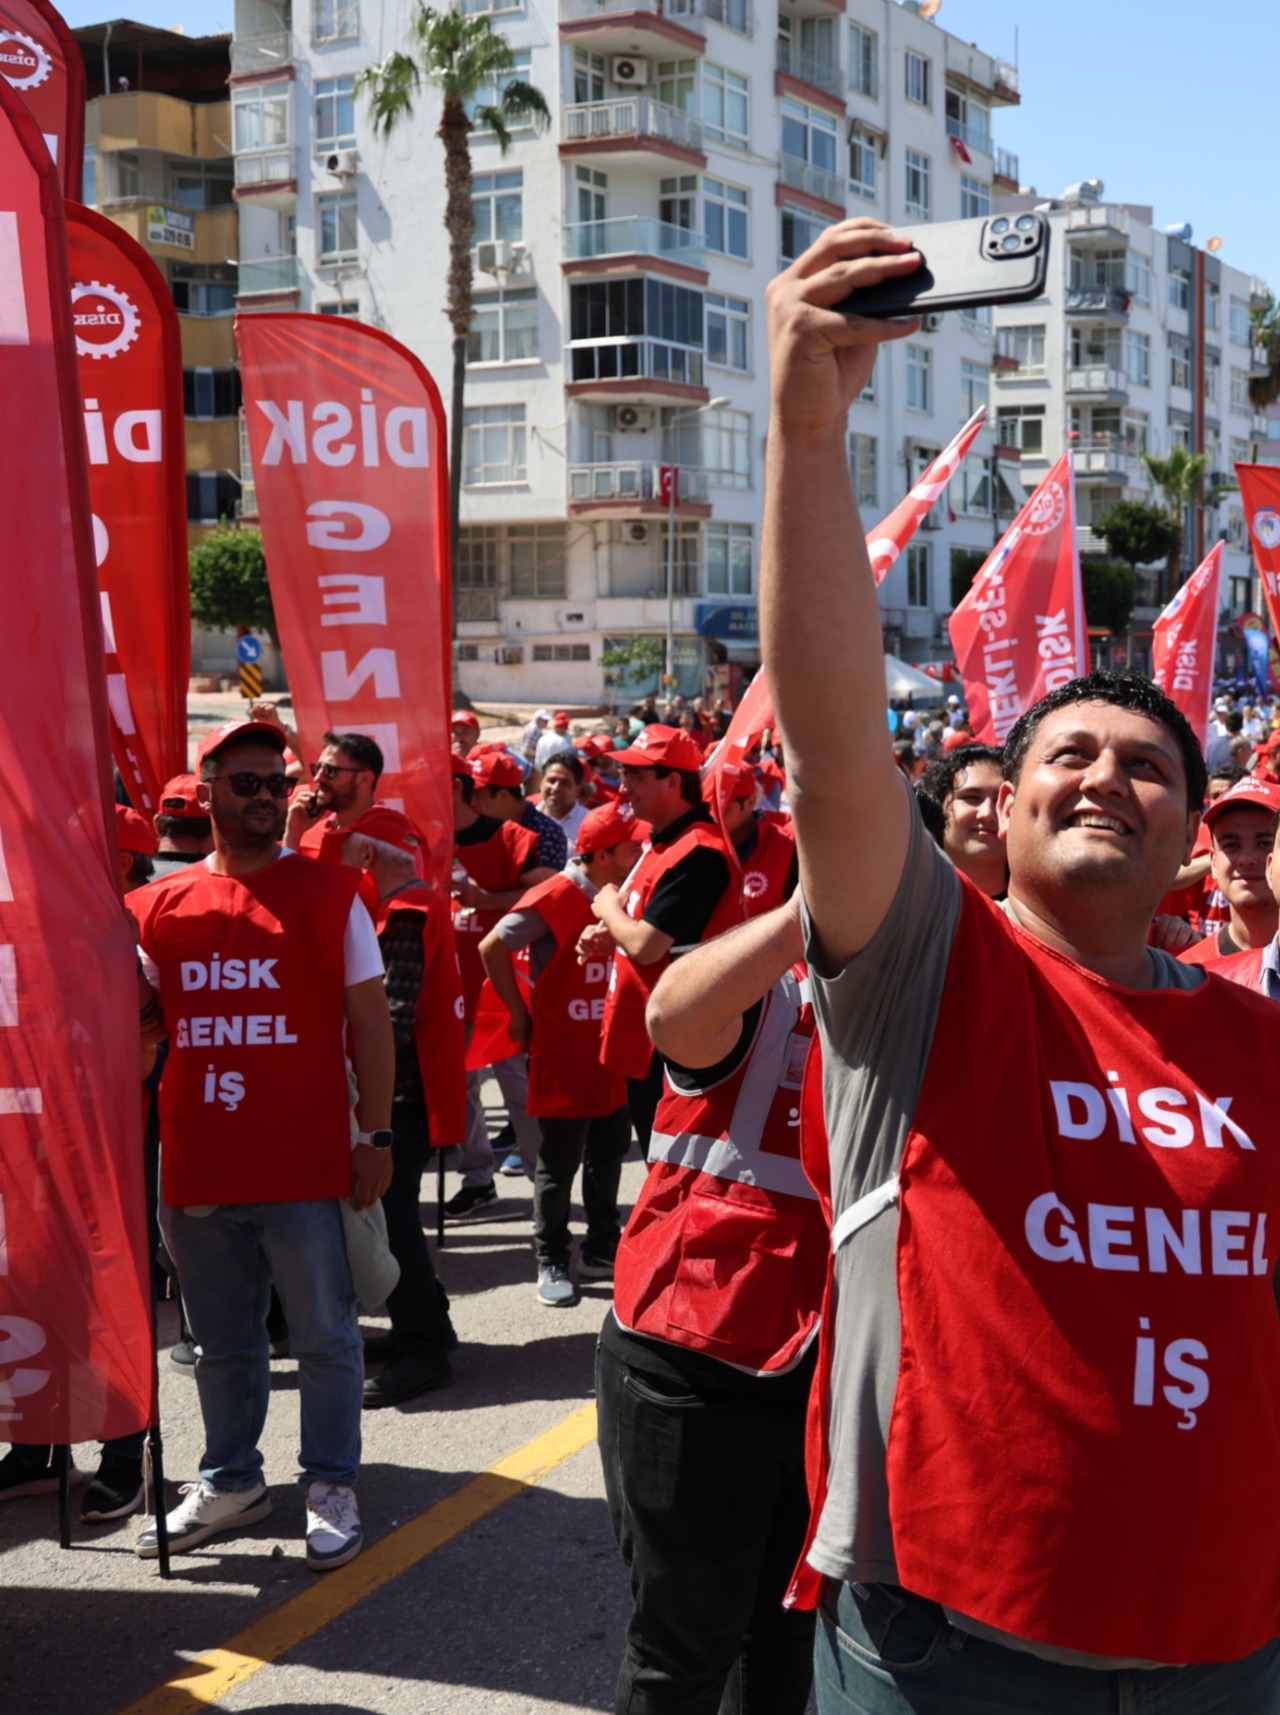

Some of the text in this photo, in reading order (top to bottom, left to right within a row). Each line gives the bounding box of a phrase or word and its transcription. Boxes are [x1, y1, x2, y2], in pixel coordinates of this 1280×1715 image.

[181, 953, 281, 992] DİSK
[176, 1015, 298, 1048] GENEL
[204, 1064, 246, 1112] İŞ
[1049, 1070, 1257, 1151] DİSK
[1024, 1191, 1269, 1276] GENEL
[1133, 1317, 1210, 1430] İŞ
